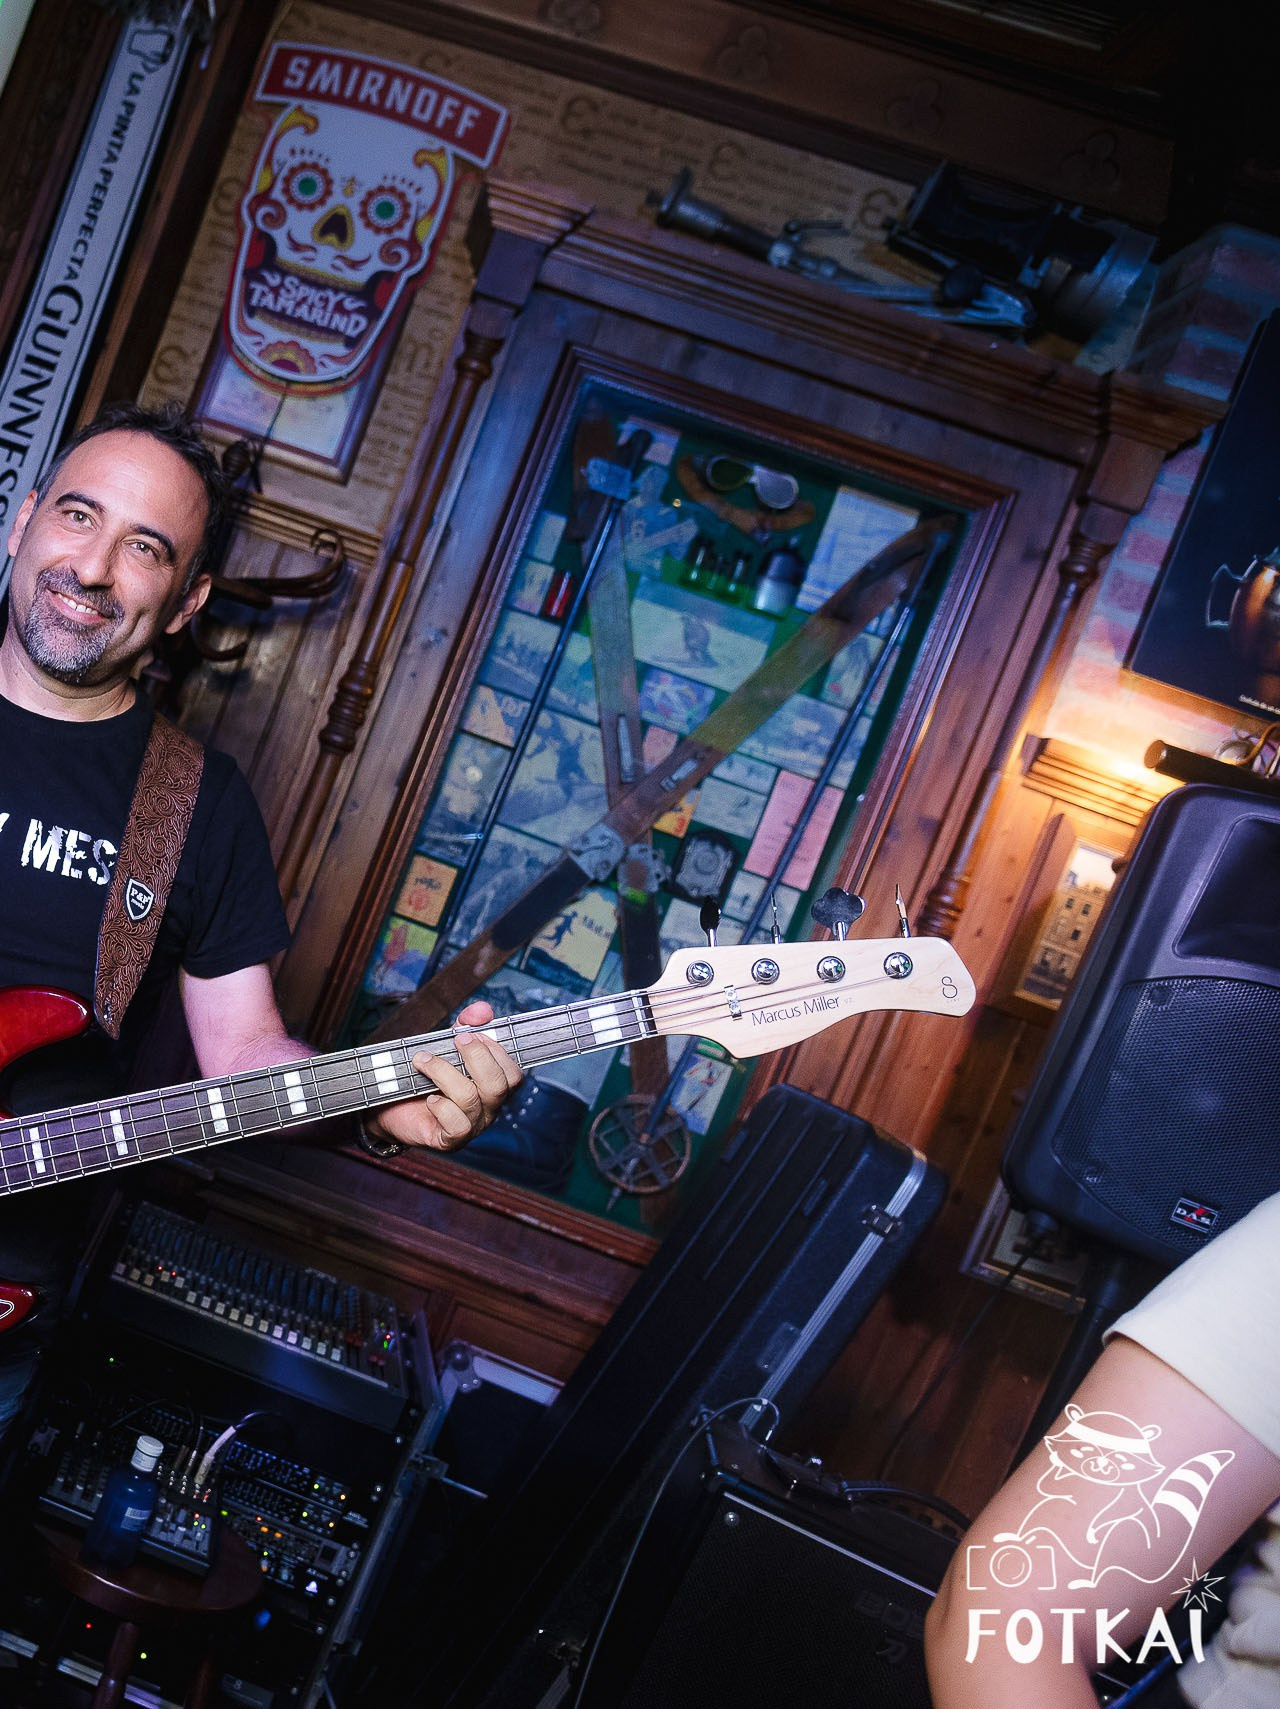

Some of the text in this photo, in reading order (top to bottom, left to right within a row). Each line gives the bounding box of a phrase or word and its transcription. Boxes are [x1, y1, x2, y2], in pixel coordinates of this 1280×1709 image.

[124, 71, 146, 97] LA
[283, 55, 482, 138] SMIRNOFF
[102, 101, 136, 165] PINTA
[63, 166, 114, 281] PERFECTA
[249, 281, 369, 338] TAMARIND
[279, 275, 346, 312] SPICY
[751, 1006, 801, 1026] Marcus
[803, 996, 840, 1015] Miller
